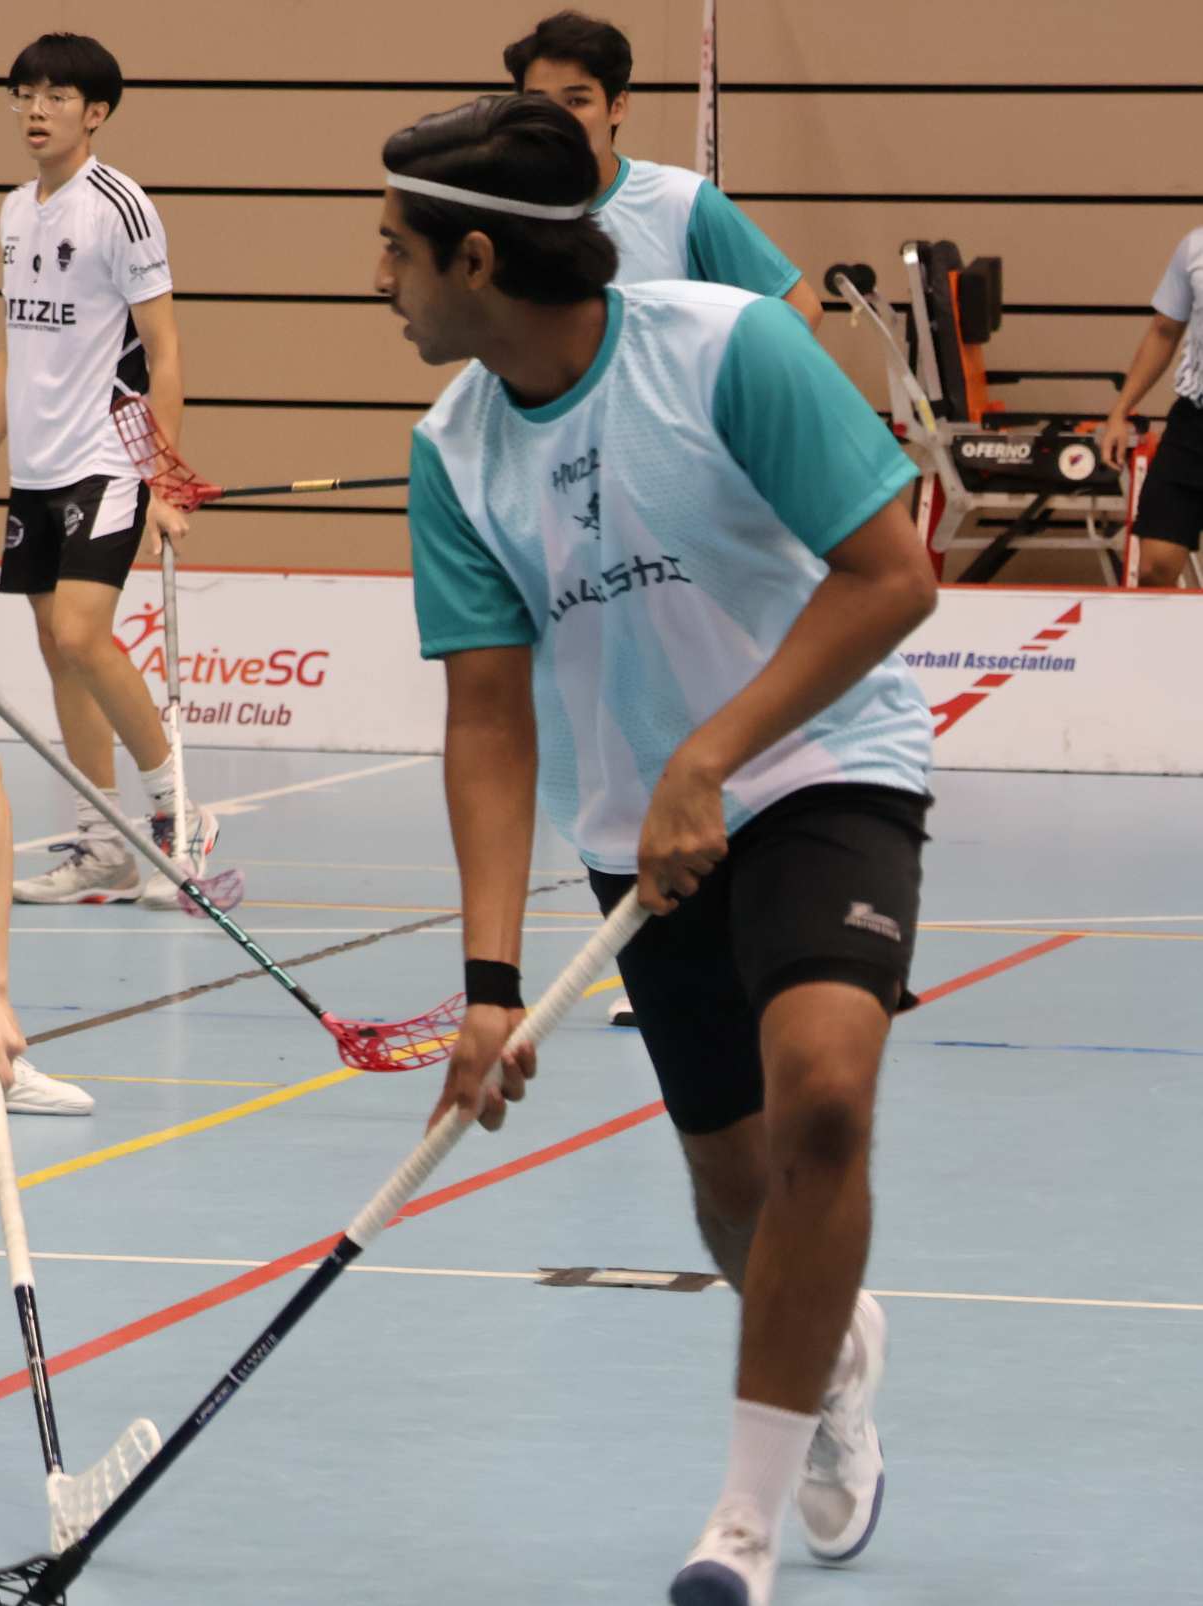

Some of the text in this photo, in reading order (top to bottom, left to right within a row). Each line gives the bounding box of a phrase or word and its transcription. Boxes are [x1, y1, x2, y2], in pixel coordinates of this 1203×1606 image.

[900, 651, 1076, 672] orball Association
[237, 703, 292, 726] Club
